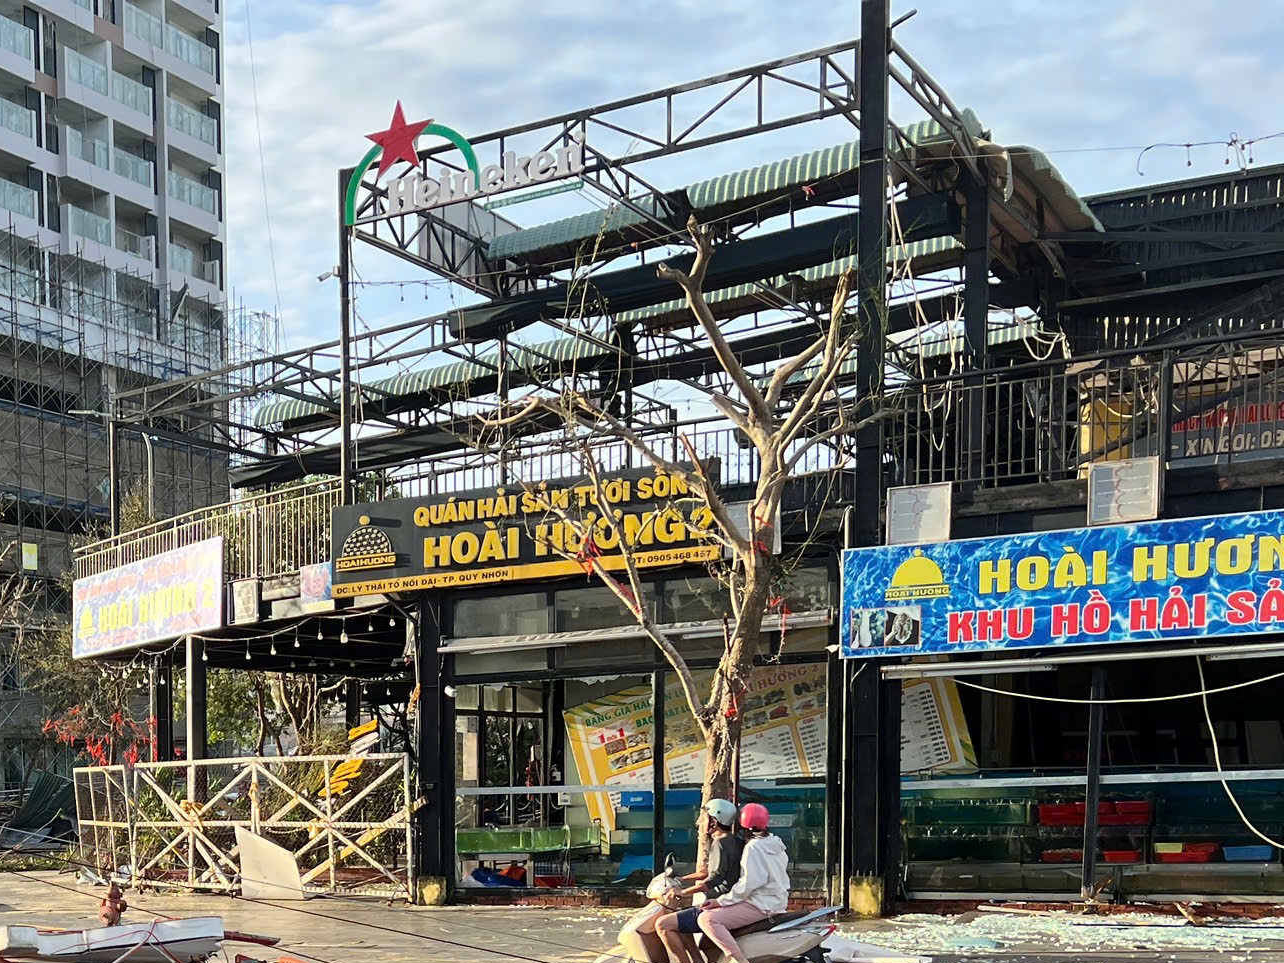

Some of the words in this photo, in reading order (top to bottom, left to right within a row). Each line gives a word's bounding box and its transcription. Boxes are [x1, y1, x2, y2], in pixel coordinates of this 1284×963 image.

[386, 137, 586, 217] Heineken
[414, 497, 475, 528] QUÁN
[477, 487, 516, 519] HẢI
[423, 520, 520, 569] HOÀI
[690, 507, 714, 540] 2
[978, 546, 1108, 595] HOÀI
[947, 606, 1034, 644] KHU
[1050, 589, 1112, 637] HỒ
[1129, 585, 1208, 632] HẢI
[1225, 577, 1284, 625] SẢ
